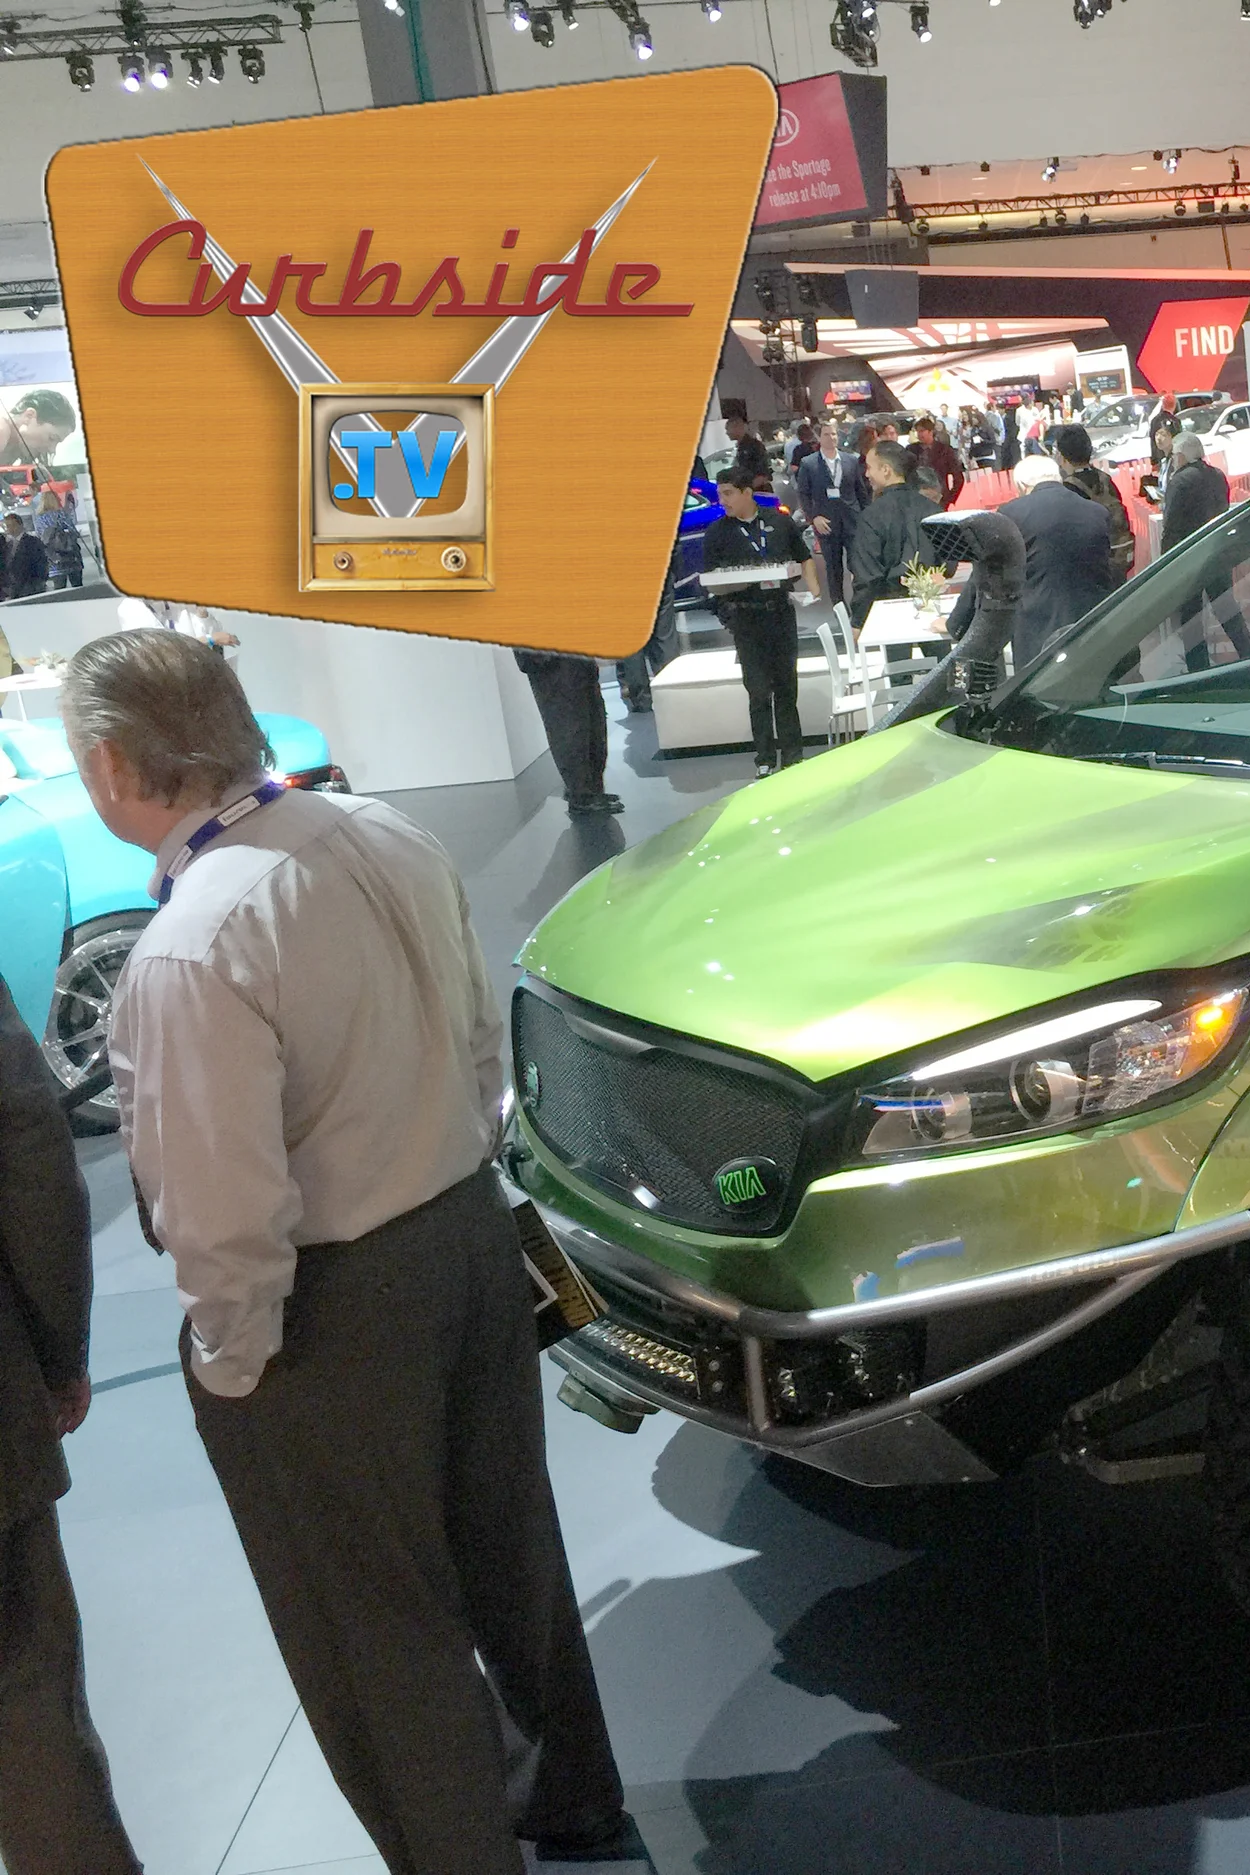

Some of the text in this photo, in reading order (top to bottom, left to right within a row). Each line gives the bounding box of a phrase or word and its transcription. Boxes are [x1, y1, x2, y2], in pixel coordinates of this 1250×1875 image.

[766, 158, 832, 182] ee the Sportage
[769, 181, 841, 207] release at 4:10pm
[1174, 325, 1235, 358] FIND
[719, 1166, 767, 1205] KIA
